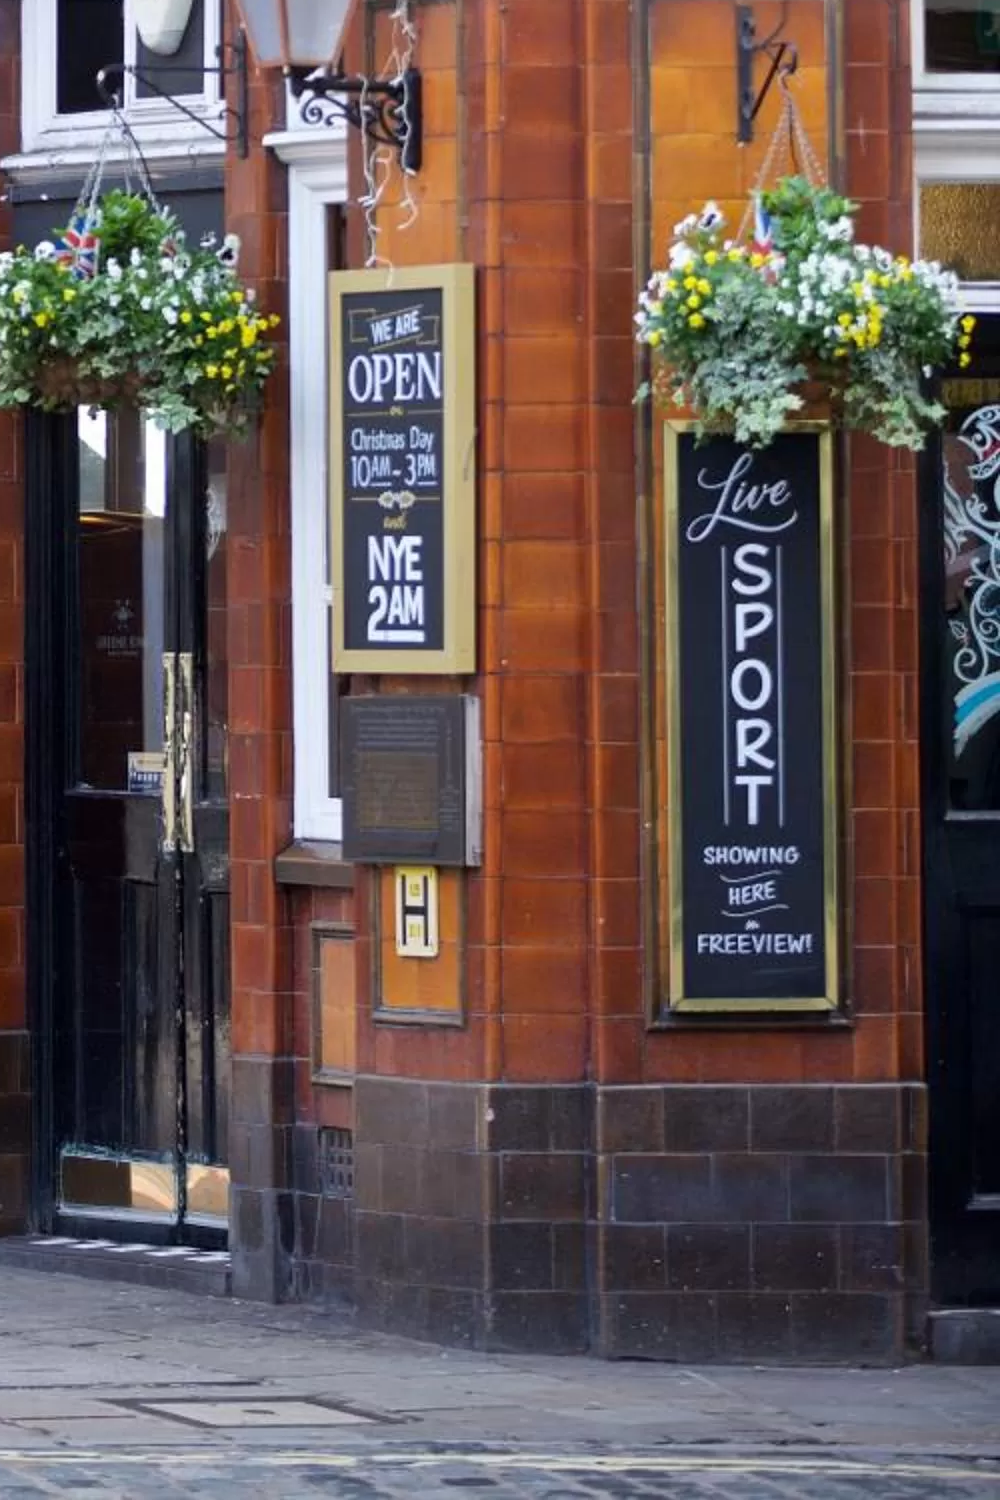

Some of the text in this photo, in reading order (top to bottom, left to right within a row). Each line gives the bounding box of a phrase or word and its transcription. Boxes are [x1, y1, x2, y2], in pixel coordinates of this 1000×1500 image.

[370, 309, 420, 344] WE ARE
[348, 352, 441, 403] OPEN
[351, 425, 434, 452] Christmas Day
[351, 455, 391, 488] 10AM
[404, 453, 437, 487] 3PM
[686, 452, 798, 541] Live
[367, 535, 423, 581] NYE
[367, 585, 425, 642] 2AM
[731, 543, 776, 826] SPORT
[703, 846, 800, 865] SHOWING
[728, 880, 777, 905] HERE
[697, 933, 813, 953] FREEVIEW!
